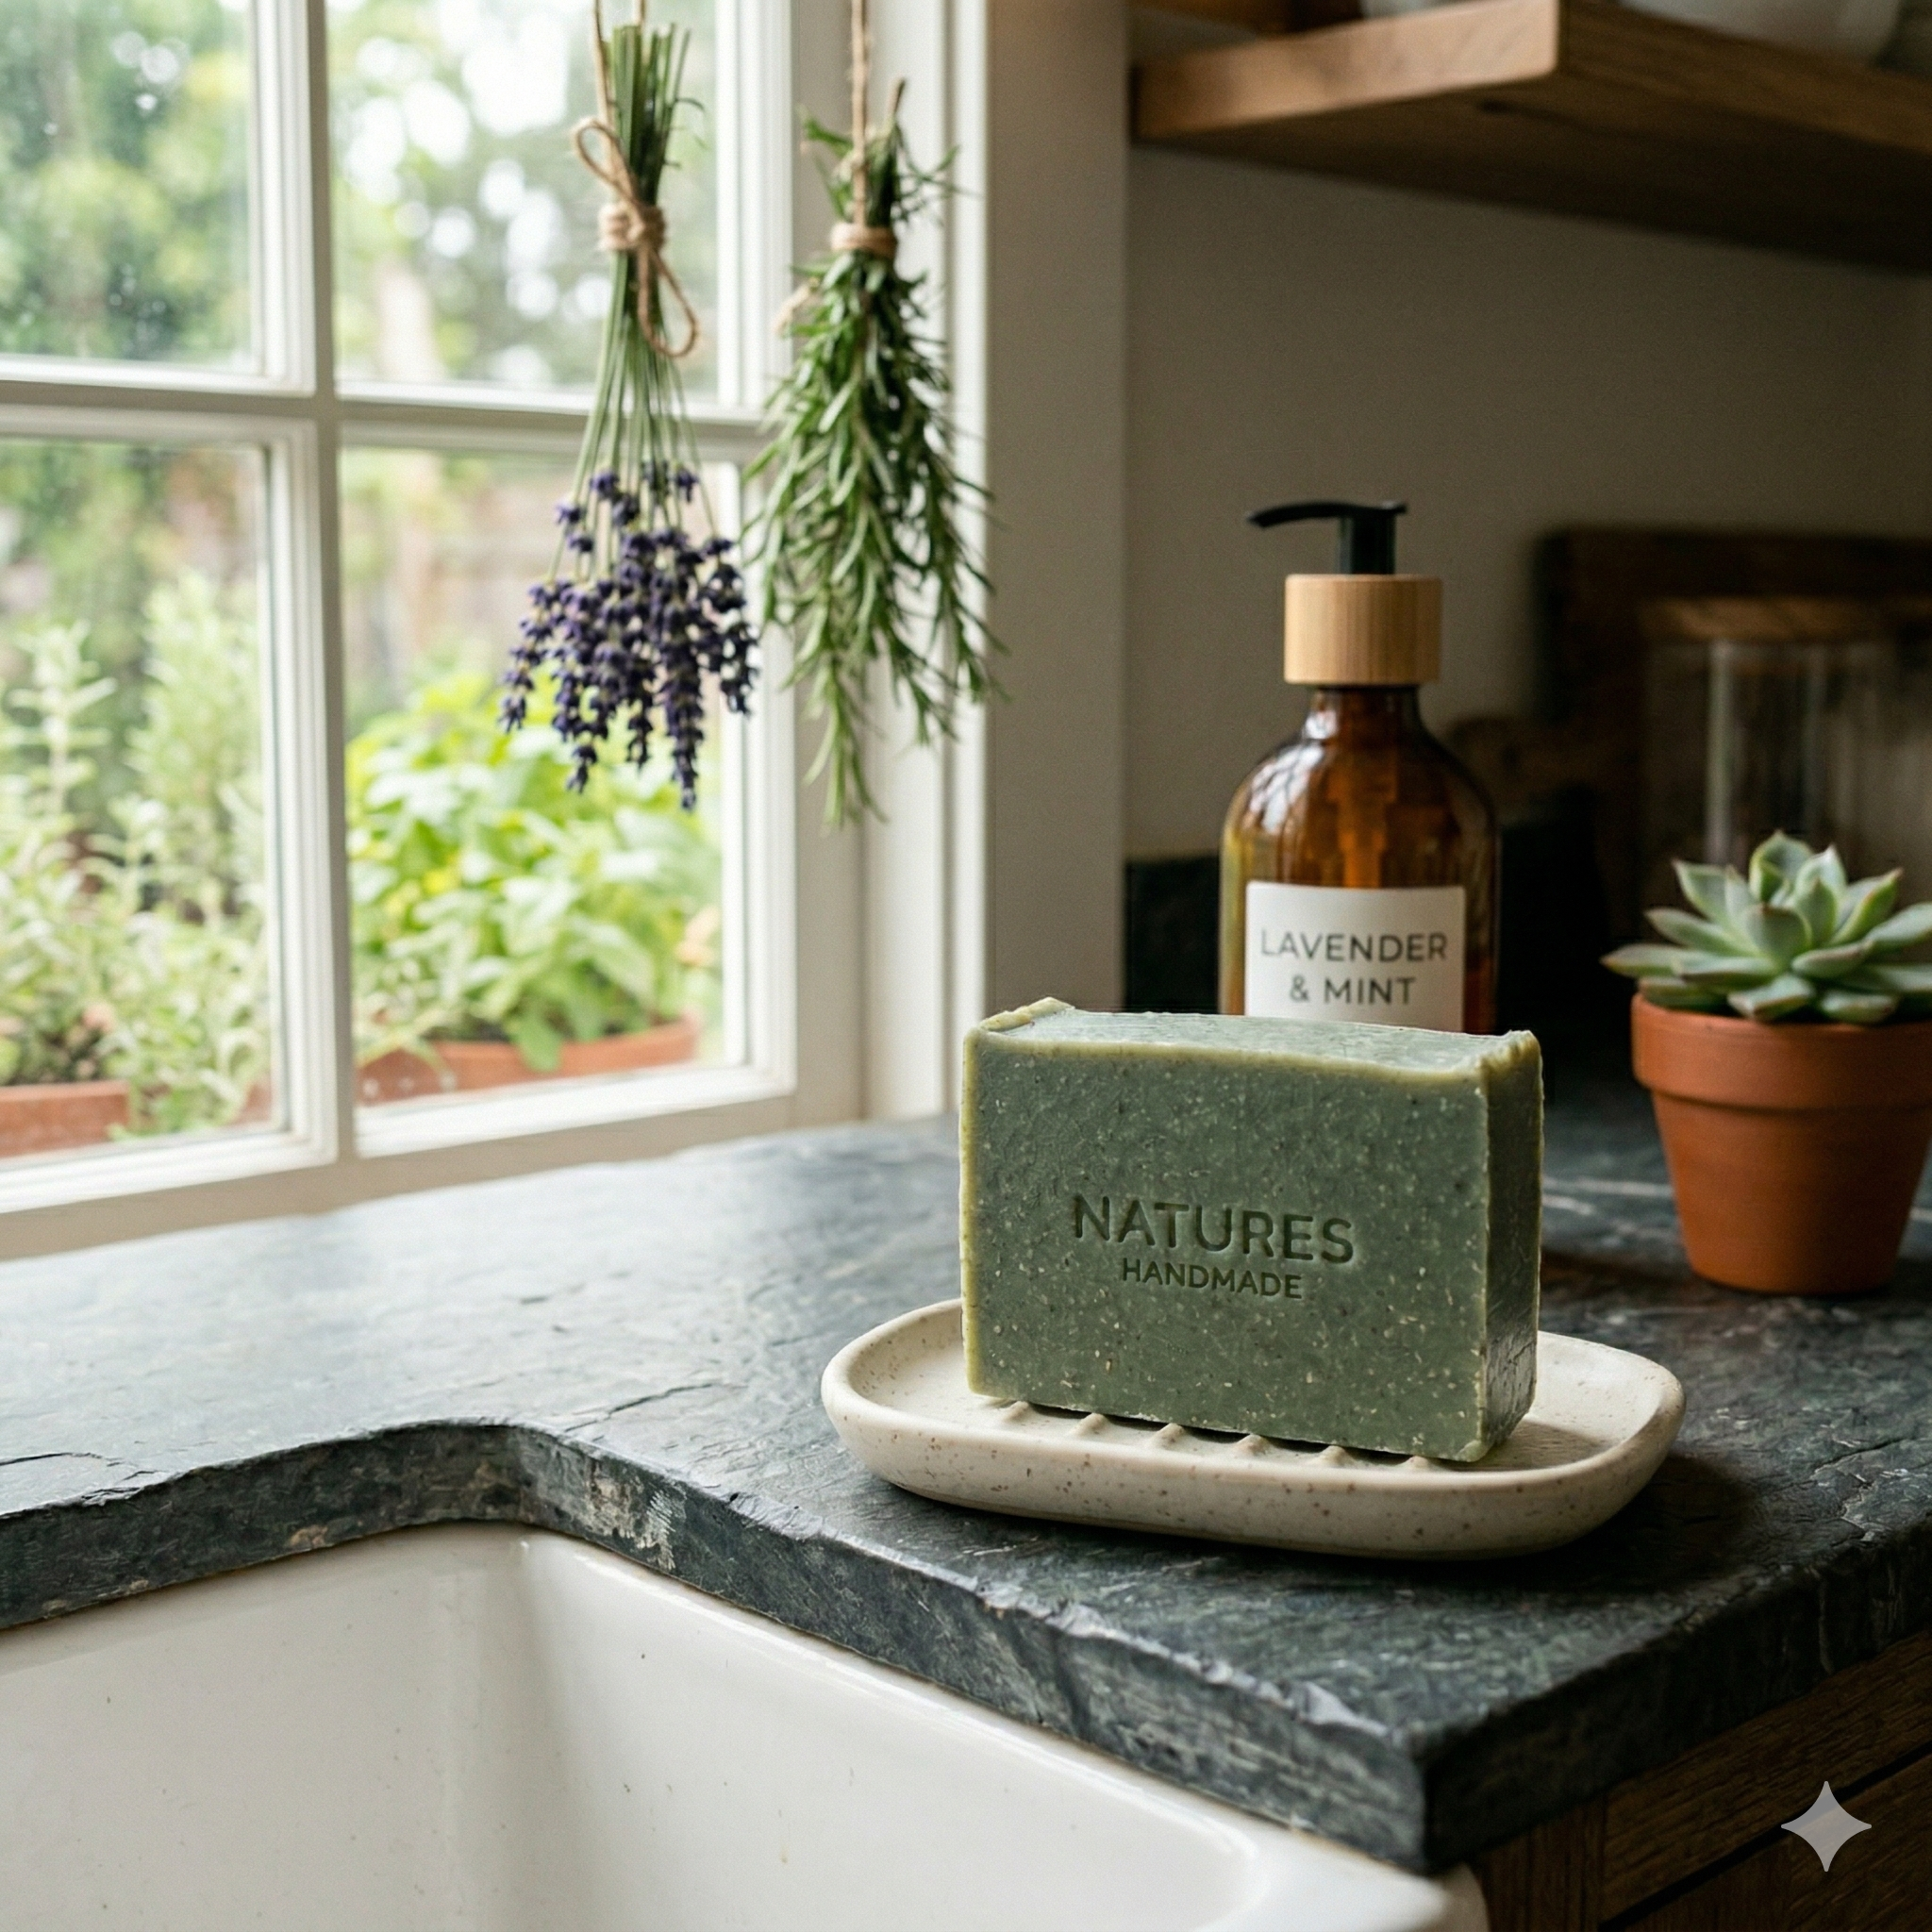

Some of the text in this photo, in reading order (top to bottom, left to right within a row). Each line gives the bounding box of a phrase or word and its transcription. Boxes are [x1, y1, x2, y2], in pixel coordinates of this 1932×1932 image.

[1261, 928, 1447, 961] LAVENDER
[1290, 975, 1416, 1004] & MINT
[1074, 1194, 1355, 1263] NATURES
[1122, 1257, 1303, 1299] HANDMADE
